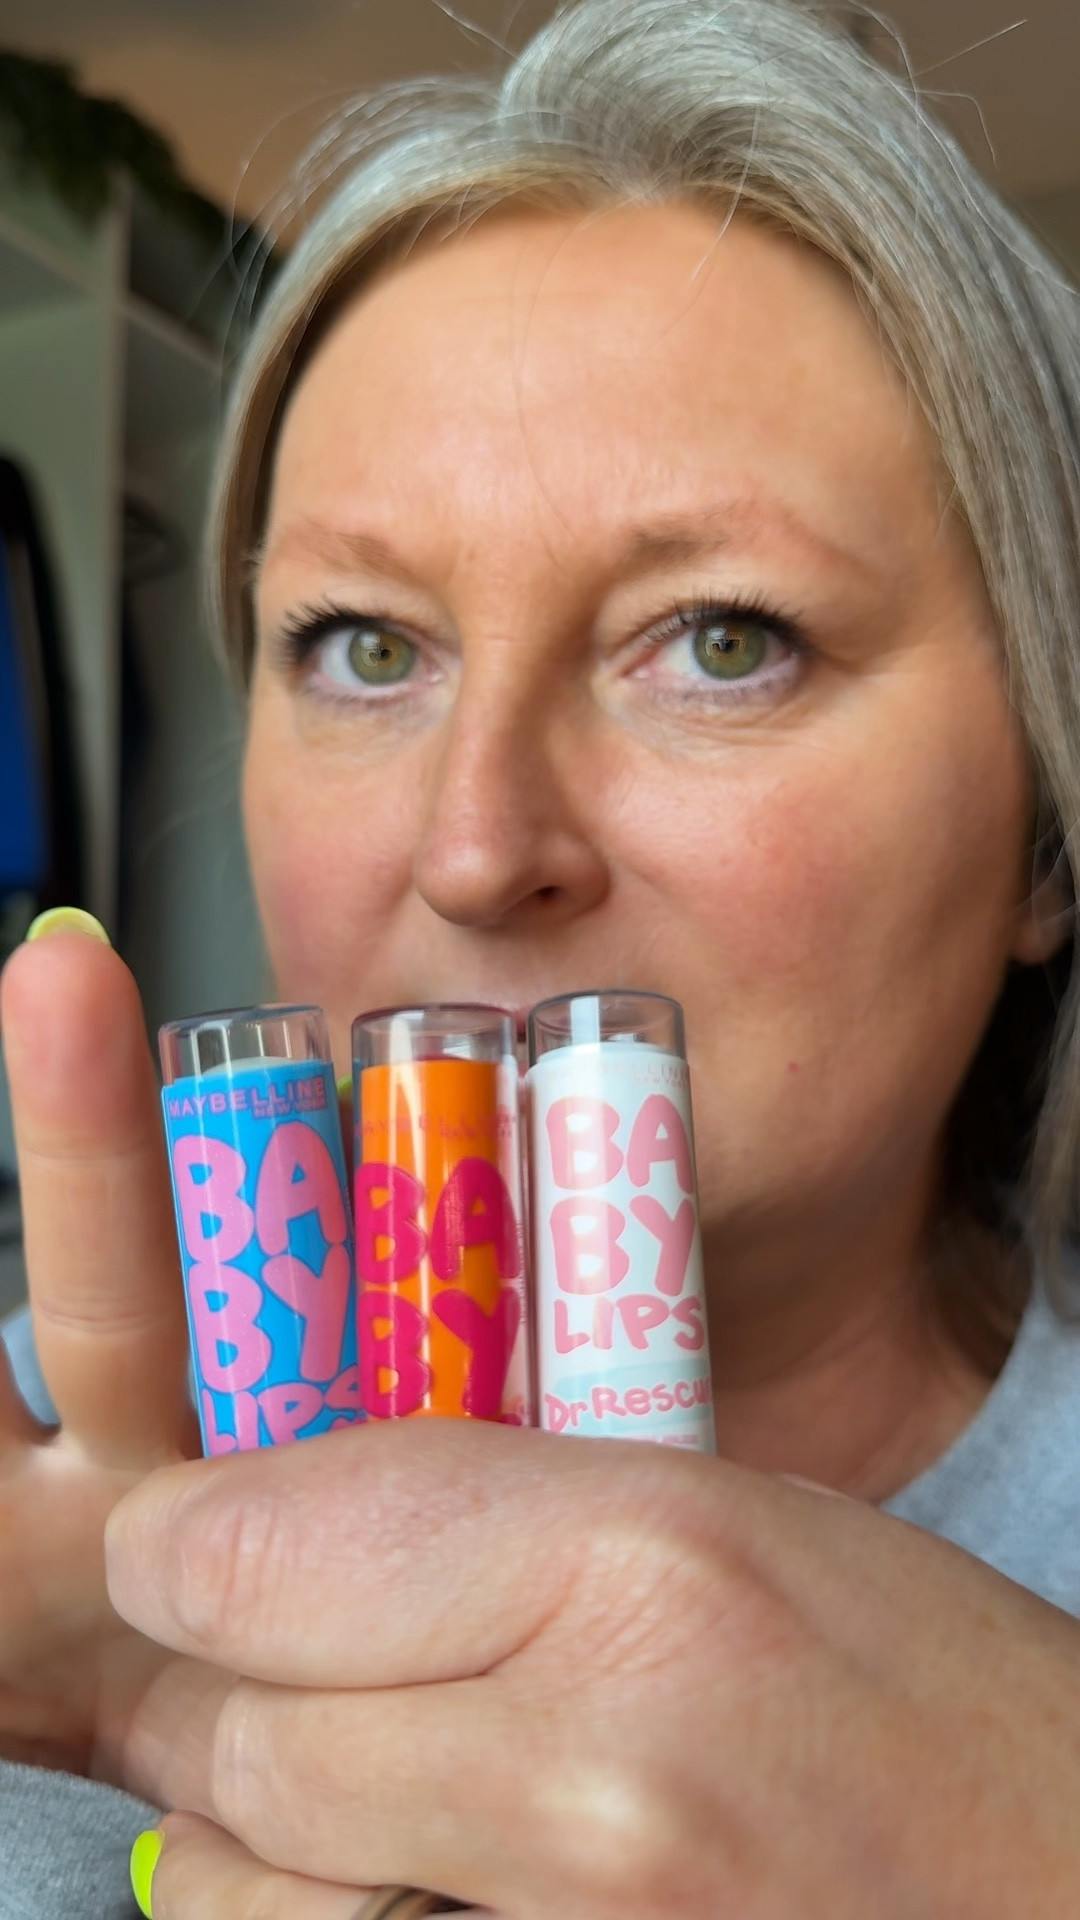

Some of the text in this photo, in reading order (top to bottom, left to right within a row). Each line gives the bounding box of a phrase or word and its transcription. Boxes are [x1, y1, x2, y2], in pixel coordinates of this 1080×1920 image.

[168, 1076, 326, 1118] MAYBELLINE
[253, 1104, 290, 1119] NEW
[545, 1092, 693, 1192] BA
[173, 1119, 348, 1264] BA
[354, 1156, 521, 1284] BA
[549, 1193, 696, 1297] BY
[188, 1243, 351, 1394] BY
[356, 1287, 520, 1418] BY
[554, 1295, 706, 1354] LIPS
[544, 1391, 588, 1433] Dr
[591, 1375, 711, 1420] Rescu
